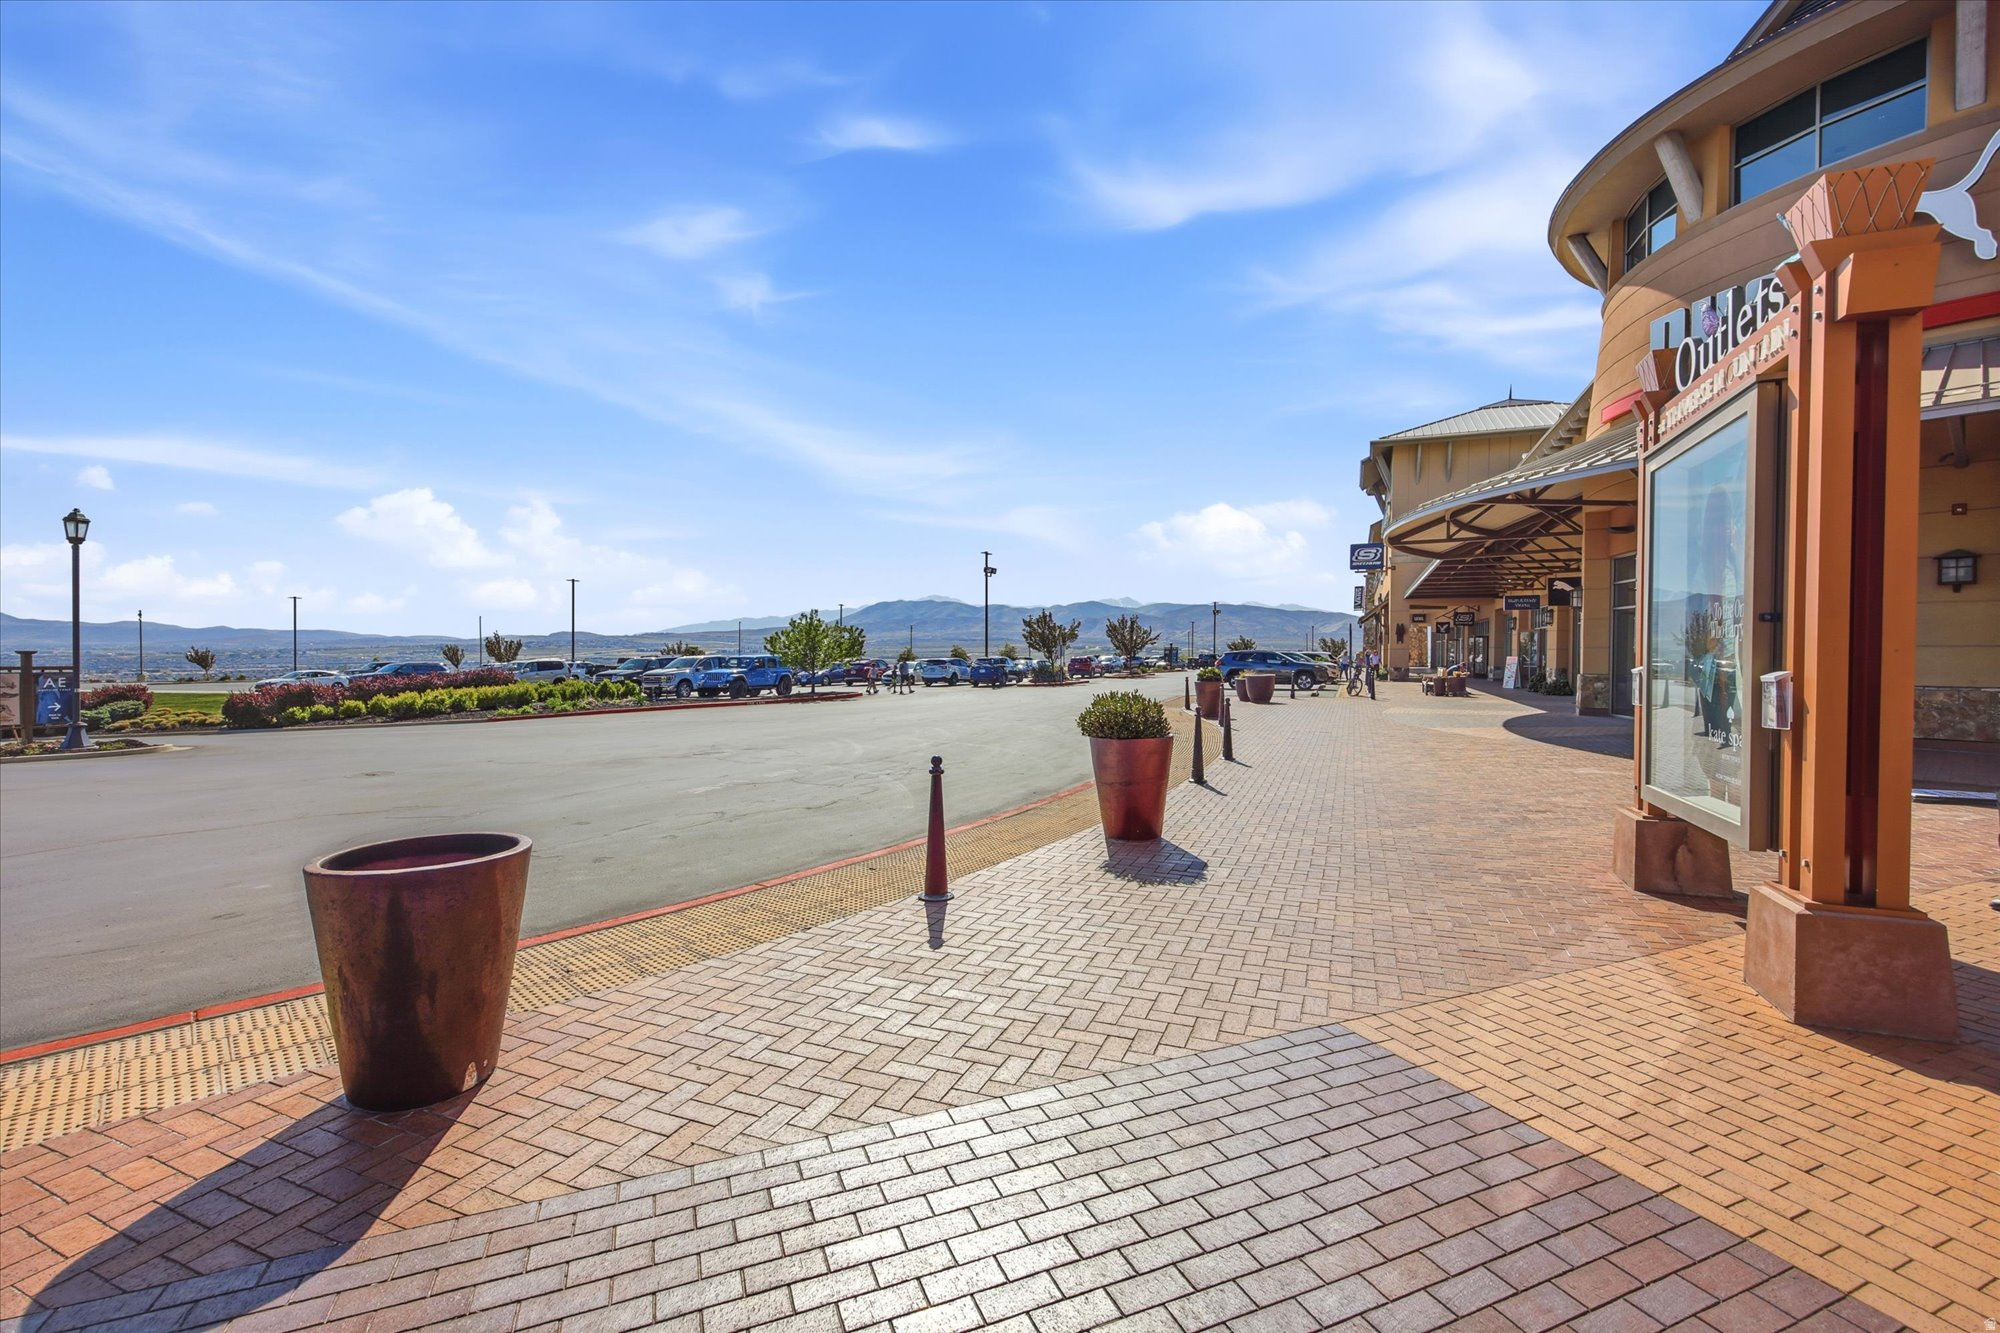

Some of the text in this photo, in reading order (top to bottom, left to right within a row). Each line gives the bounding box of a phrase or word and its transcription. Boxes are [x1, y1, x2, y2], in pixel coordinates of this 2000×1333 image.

[1675, 277, 1786, 392] Outlets
[43, 677, 66, 688] AE
[1708, 723, 1727, 744] kate
